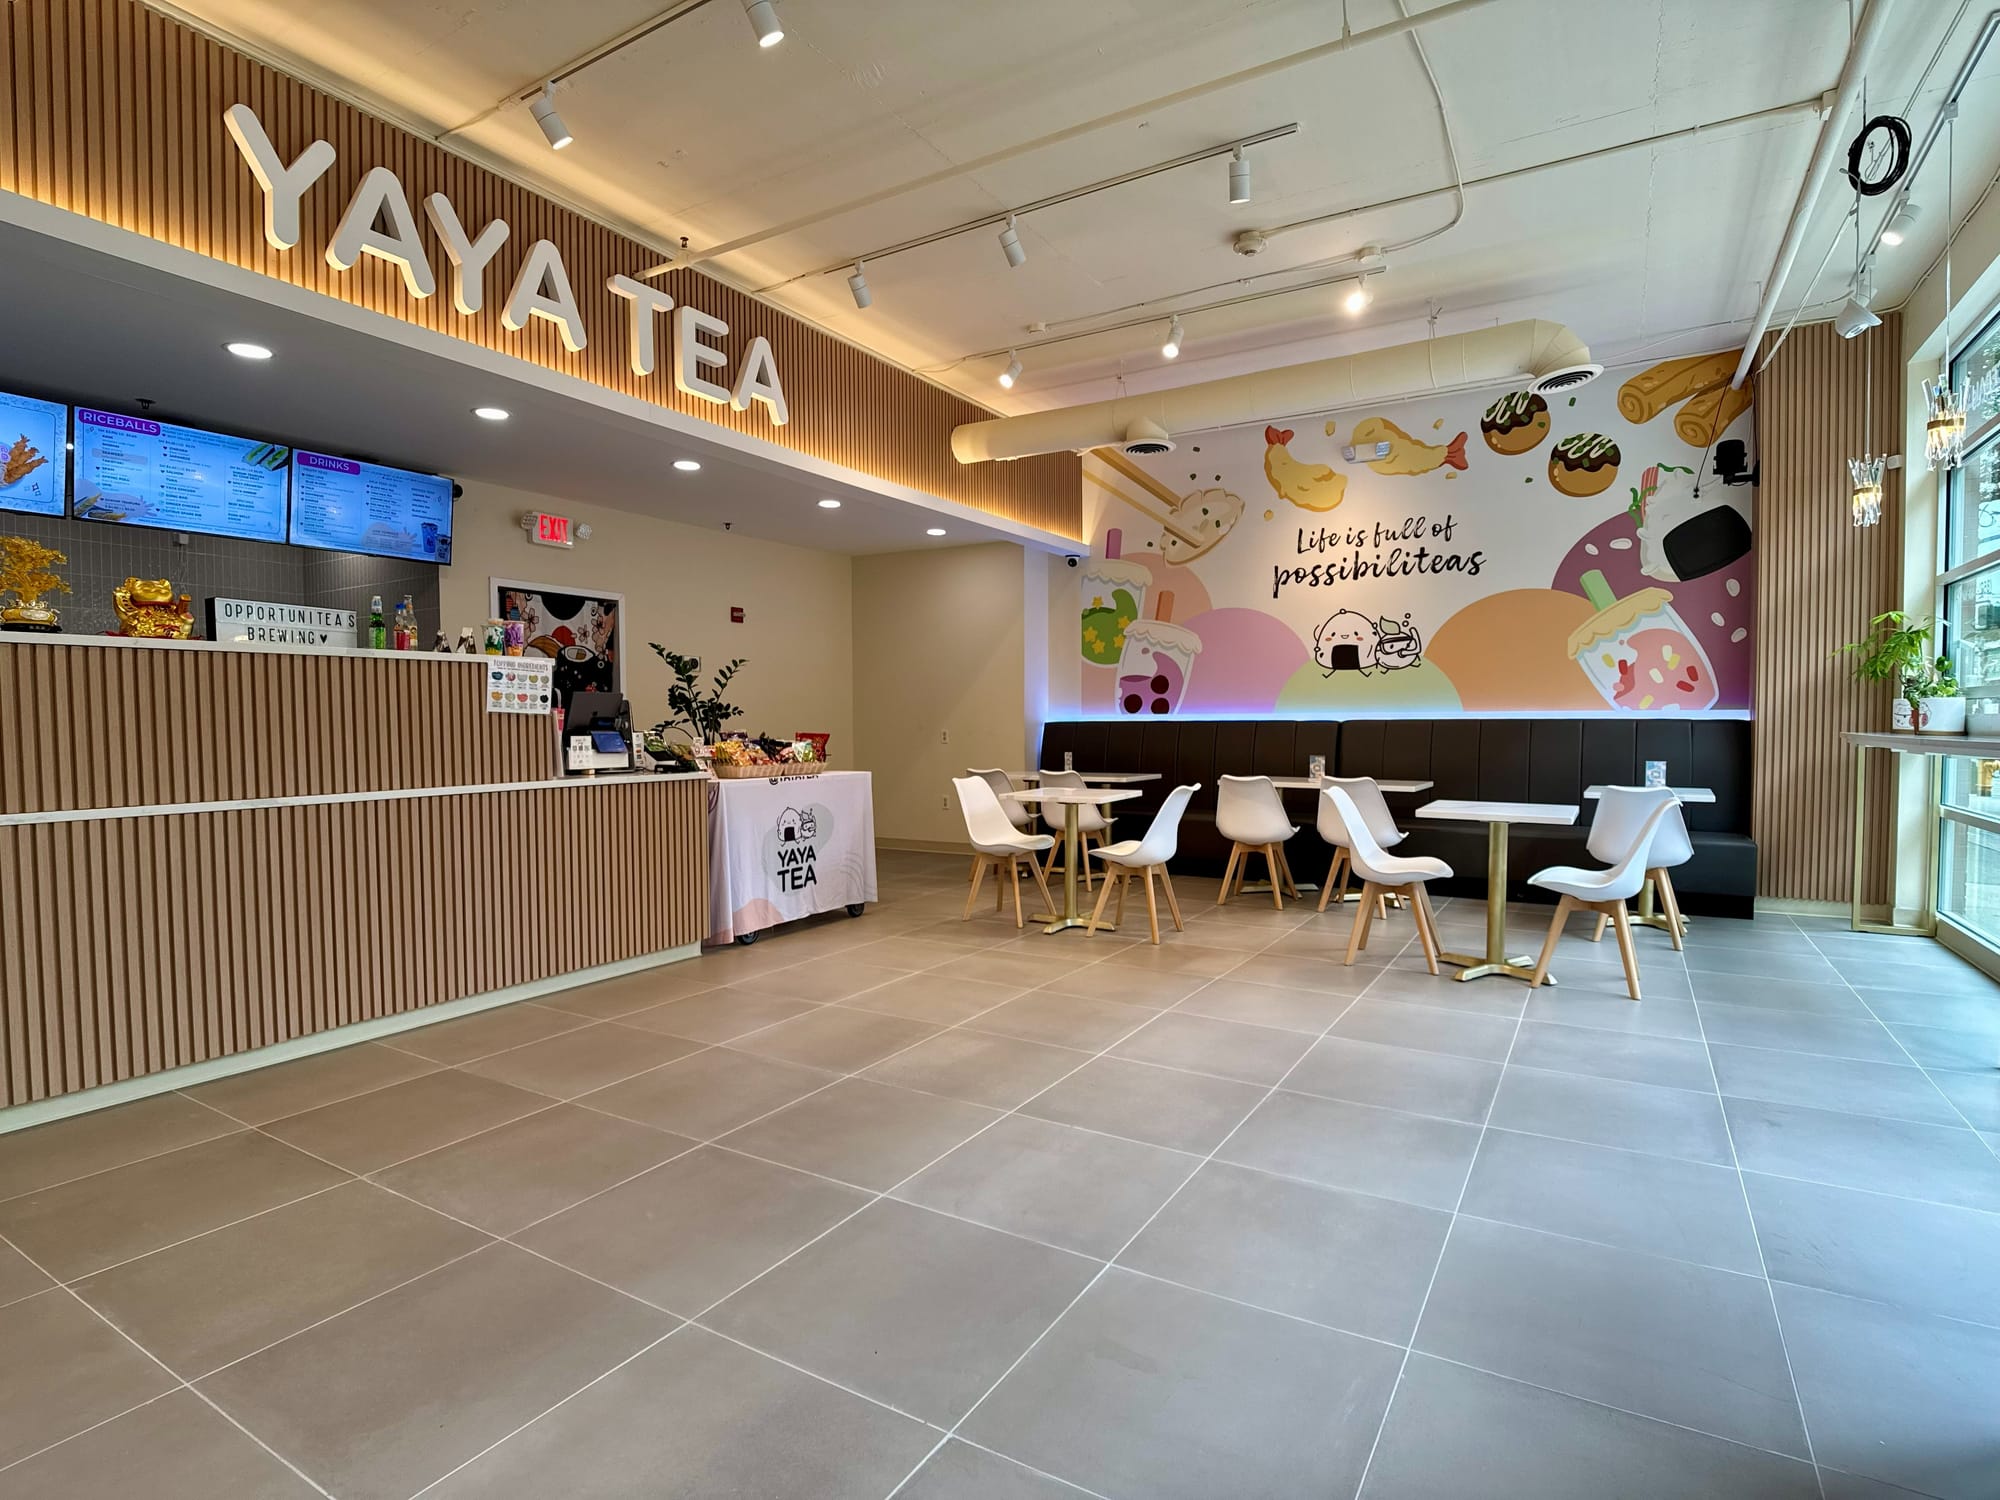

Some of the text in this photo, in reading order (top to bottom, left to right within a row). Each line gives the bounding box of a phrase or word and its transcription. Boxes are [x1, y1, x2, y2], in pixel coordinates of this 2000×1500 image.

[224, 103, 789, 427] YAYA TEA
[83, 411, 158, 433] RICEBALLS
[309, 456, 350, 471] DRINKS
[539, 513, 569, 544] EXIT
[1297, 514, 1458, 554] Life is full of
[1272, 546, 1487, 599] possibiliteas
[247, 627, 315, 645] BREWING
[777, 845, 817, 868] YAYA
[777, 864, 817, 893] TEA
